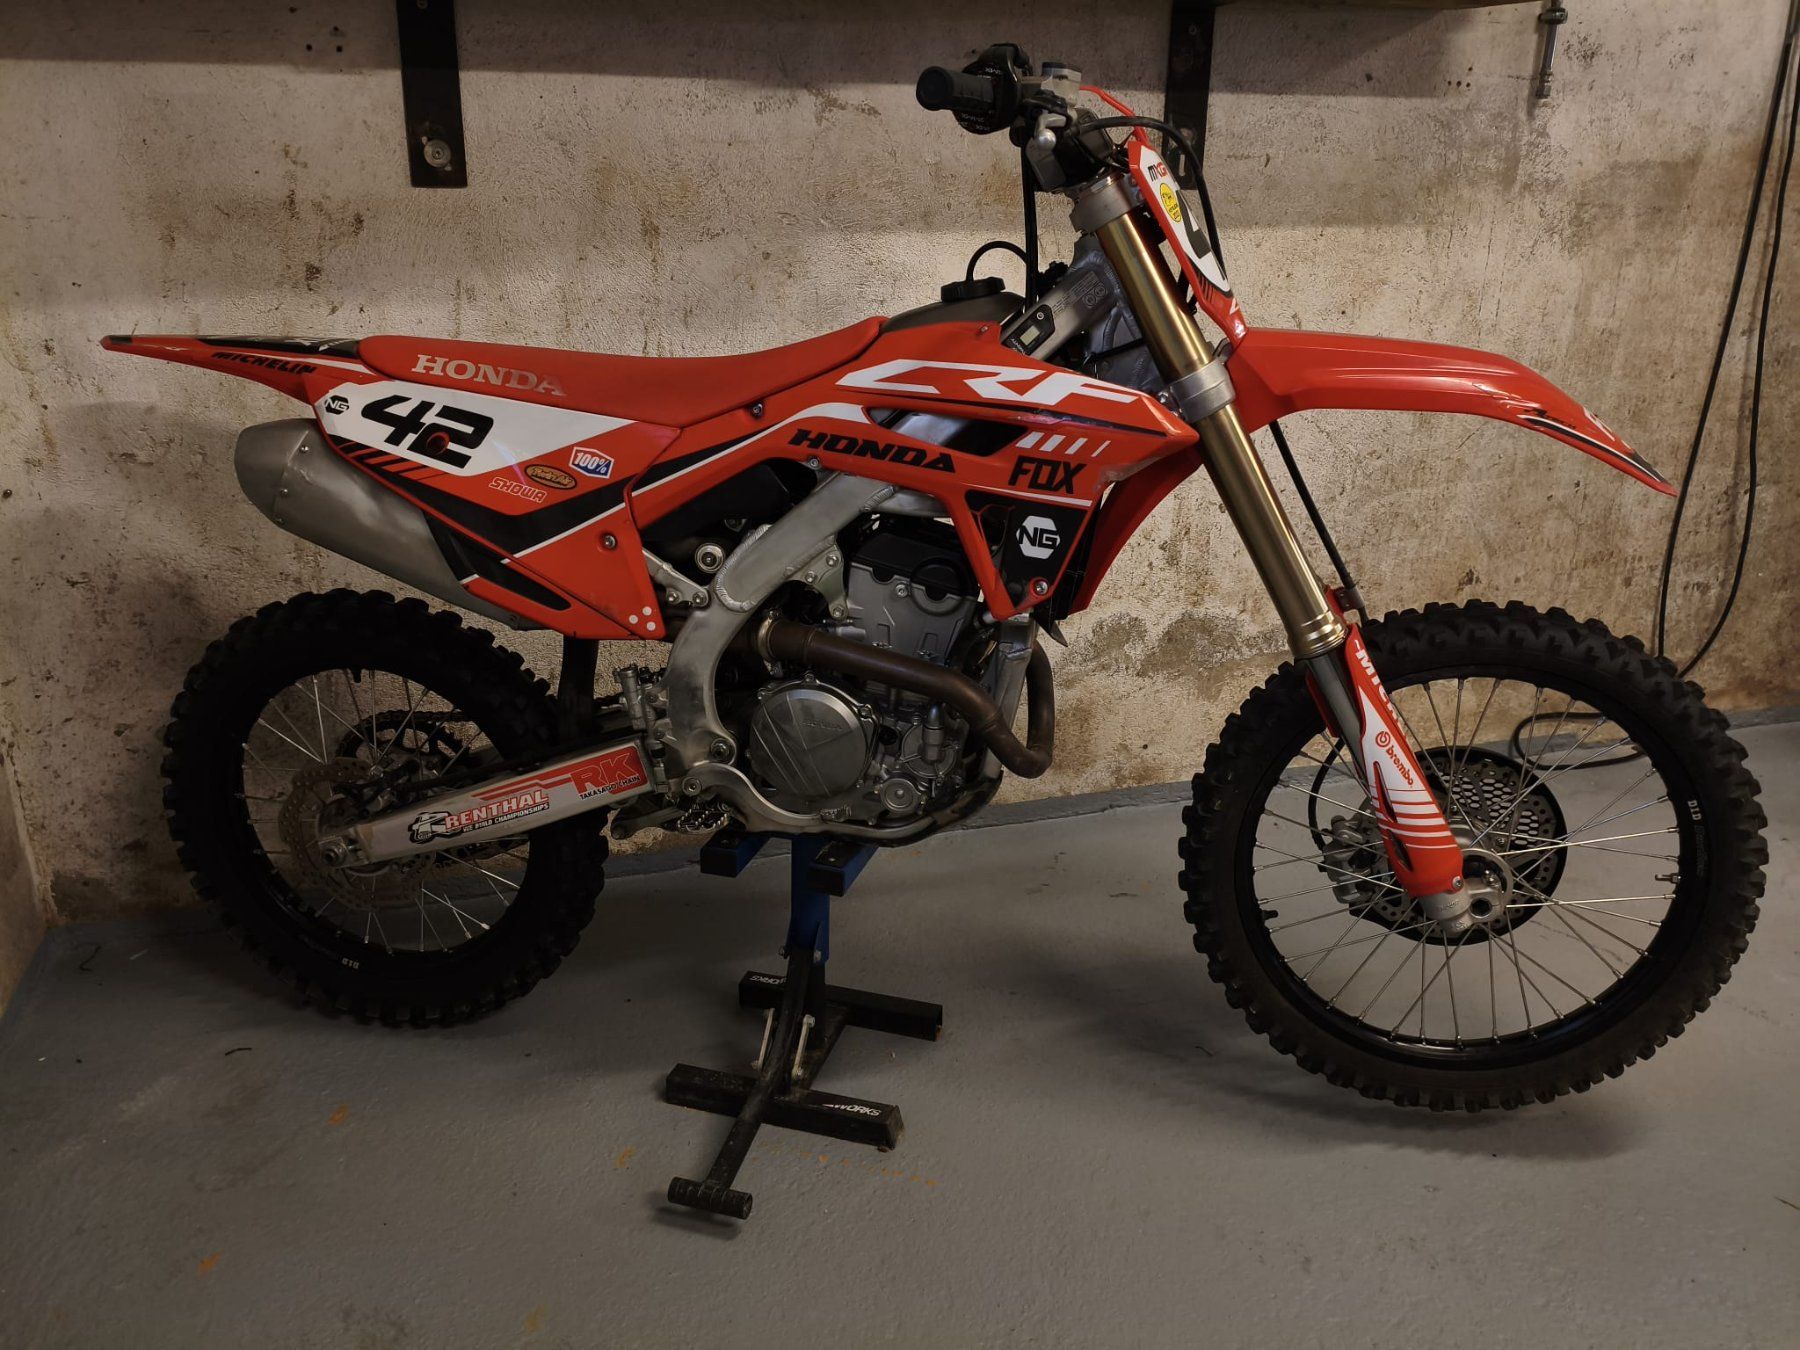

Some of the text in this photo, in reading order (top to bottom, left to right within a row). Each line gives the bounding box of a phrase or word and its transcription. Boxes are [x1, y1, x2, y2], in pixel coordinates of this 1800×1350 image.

[211, 351, 317, 374] MICHELIN
[411, 354, 567, 396] HONDA
[834, 359, 1148, 406] CRF
[361, 394, 494, 469] 42
[788, 428, 956, 473] HONDA
[573, 451, 607, 474] 100%
[1008, 455, 1087, 495] FOX
[489, 477, 547, 503] SHOWA
[1016, 525, 1061, 551] NG
[570, 753, 639, 794] RK
[618, 776, 640, 787] CHAIN
[1386, 745, 1413, 786] brembo
[445, 789, 549, 832] RENTHAL
[494, 801, 550, 825] CHAMPIONSHIPS
